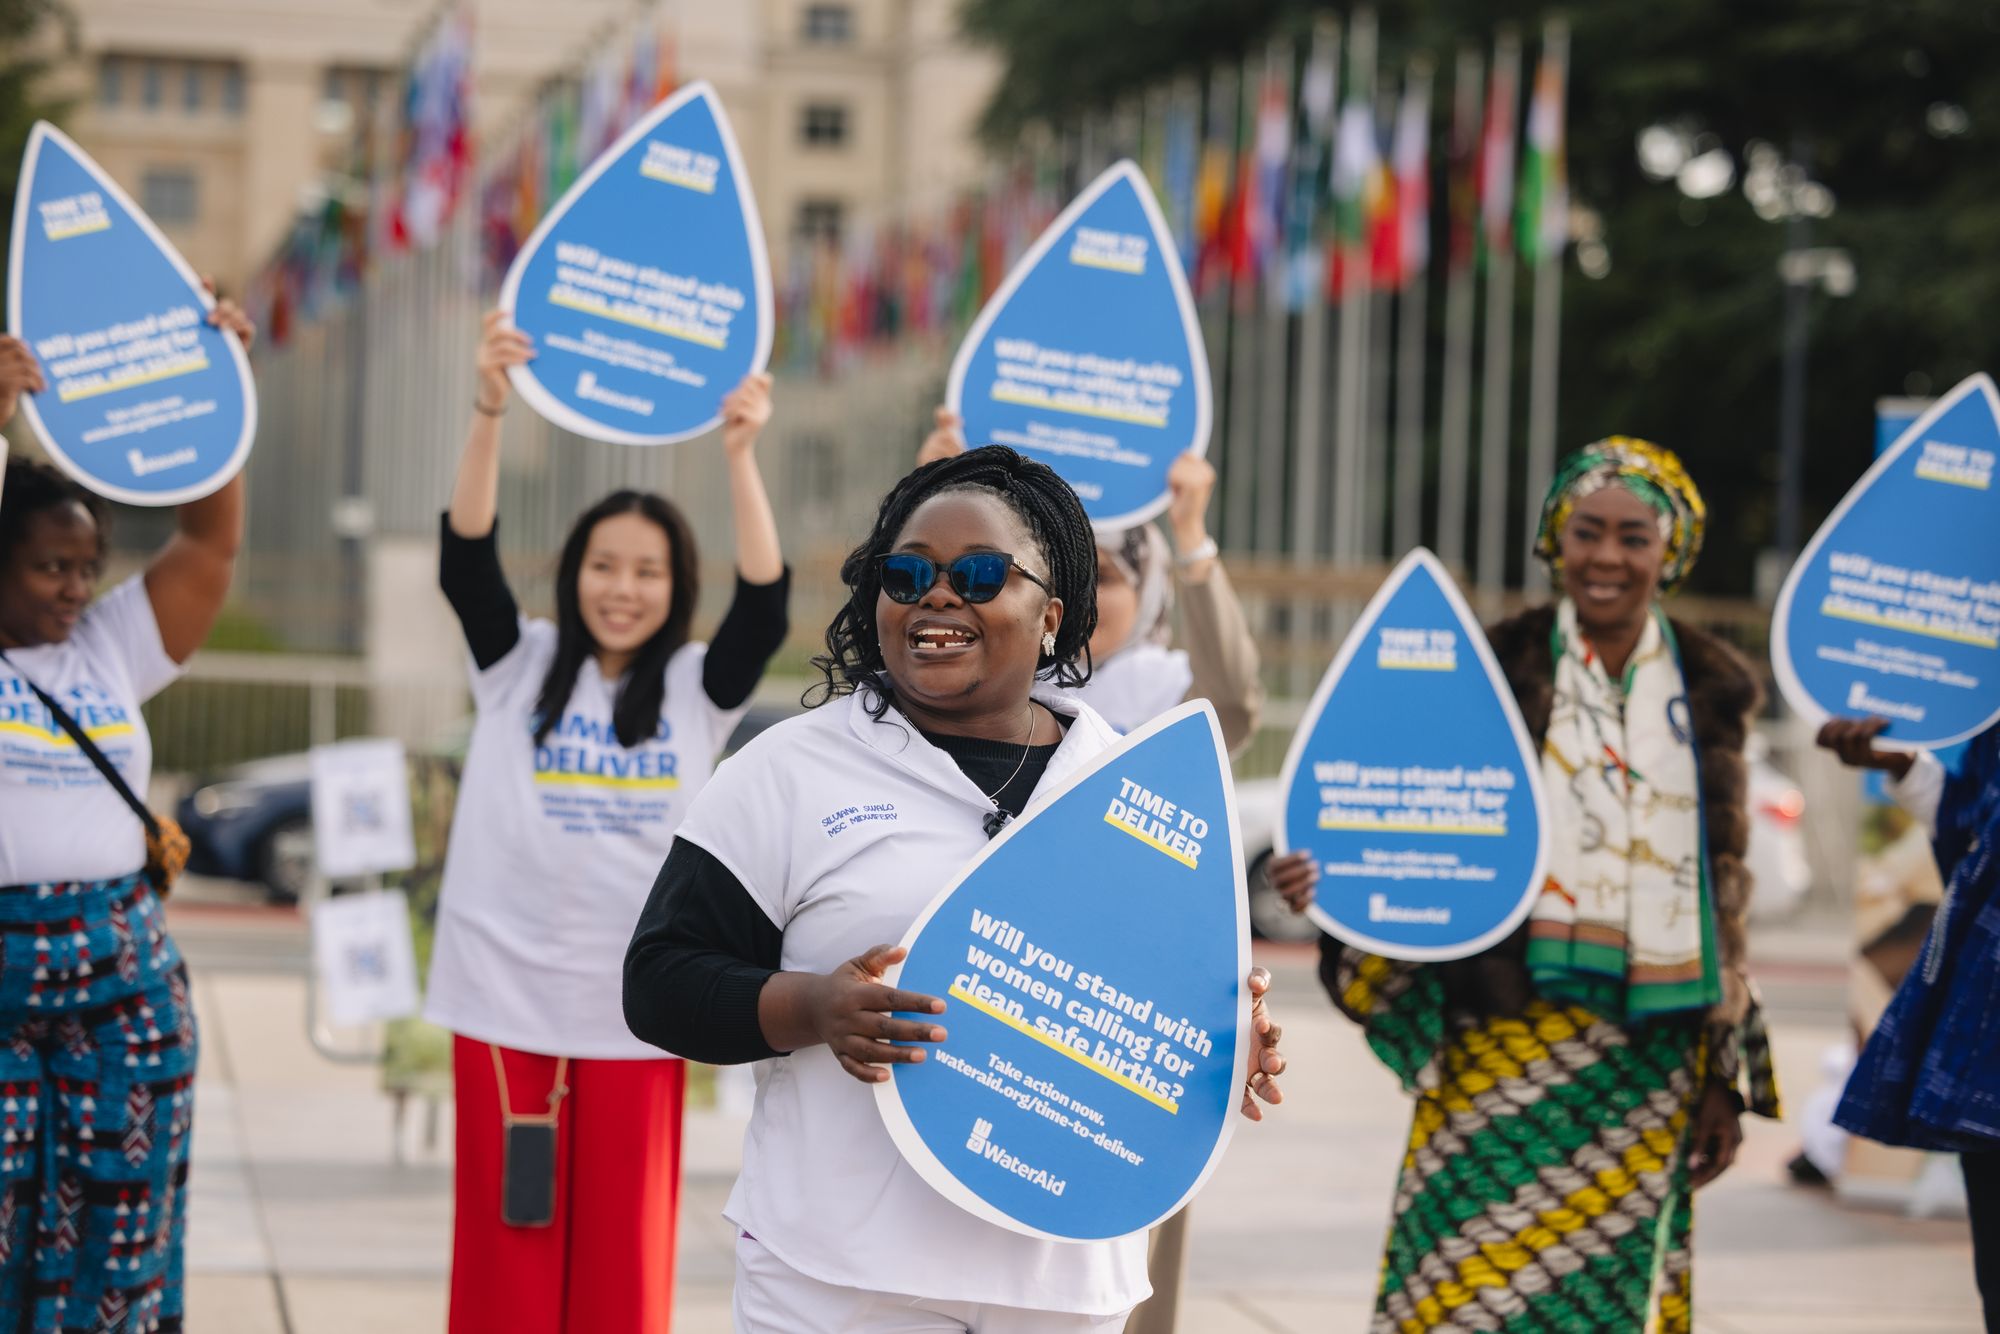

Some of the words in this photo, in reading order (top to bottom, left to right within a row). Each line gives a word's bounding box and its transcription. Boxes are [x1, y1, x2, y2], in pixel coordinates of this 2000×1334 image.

[534, 747, 678, 778] DELIVER
[1313, 761, 1356, 781] Will
[1357, 767, 1398, 786] you
[1401, 766, 1463, 785] stand
[1465, 767, 1514, 787] with
[827, 822, 848, 838] MSC
[849, 813, 898, 825] MIDWIFERY
[863, 803, 895, 812] SWALO
[1106, 797, 1203, 862] DELIVER
[1119, 777, 1178, 824] TIME
[1178, 809, 1209, 839] TO
[1319, 787, 1399, 804] women
[1401, 786, 1472, 811] calling
[1474, 788, 1508, 808] for
[967, 944, 1063, 1010] women
[1065, 1000, 1154, 1061] calling
[1153, 1042, 1195, 1078] for
[970, 908, 1025, 955] Will
[1019, 942, 1074, 982] you
[1074, 971, 1154, 1024] stand
[1153, 1012, 1212, 1057] with
[953, 973, 1029, 1026] clean,
[1032, 1015, 1090, 1057] safe
[1091, 1040, 1185, 1104] births?
[935, 1049, 1144, 1166] wateraid.org/time-to-deliver
[988, 1053, 1023, 1082] Take
[1022, 1075, 1070, 1107] action
[1069, 1100, 1105, 1127] now.
[983, 1140, 1067, 1197] WaterAid
